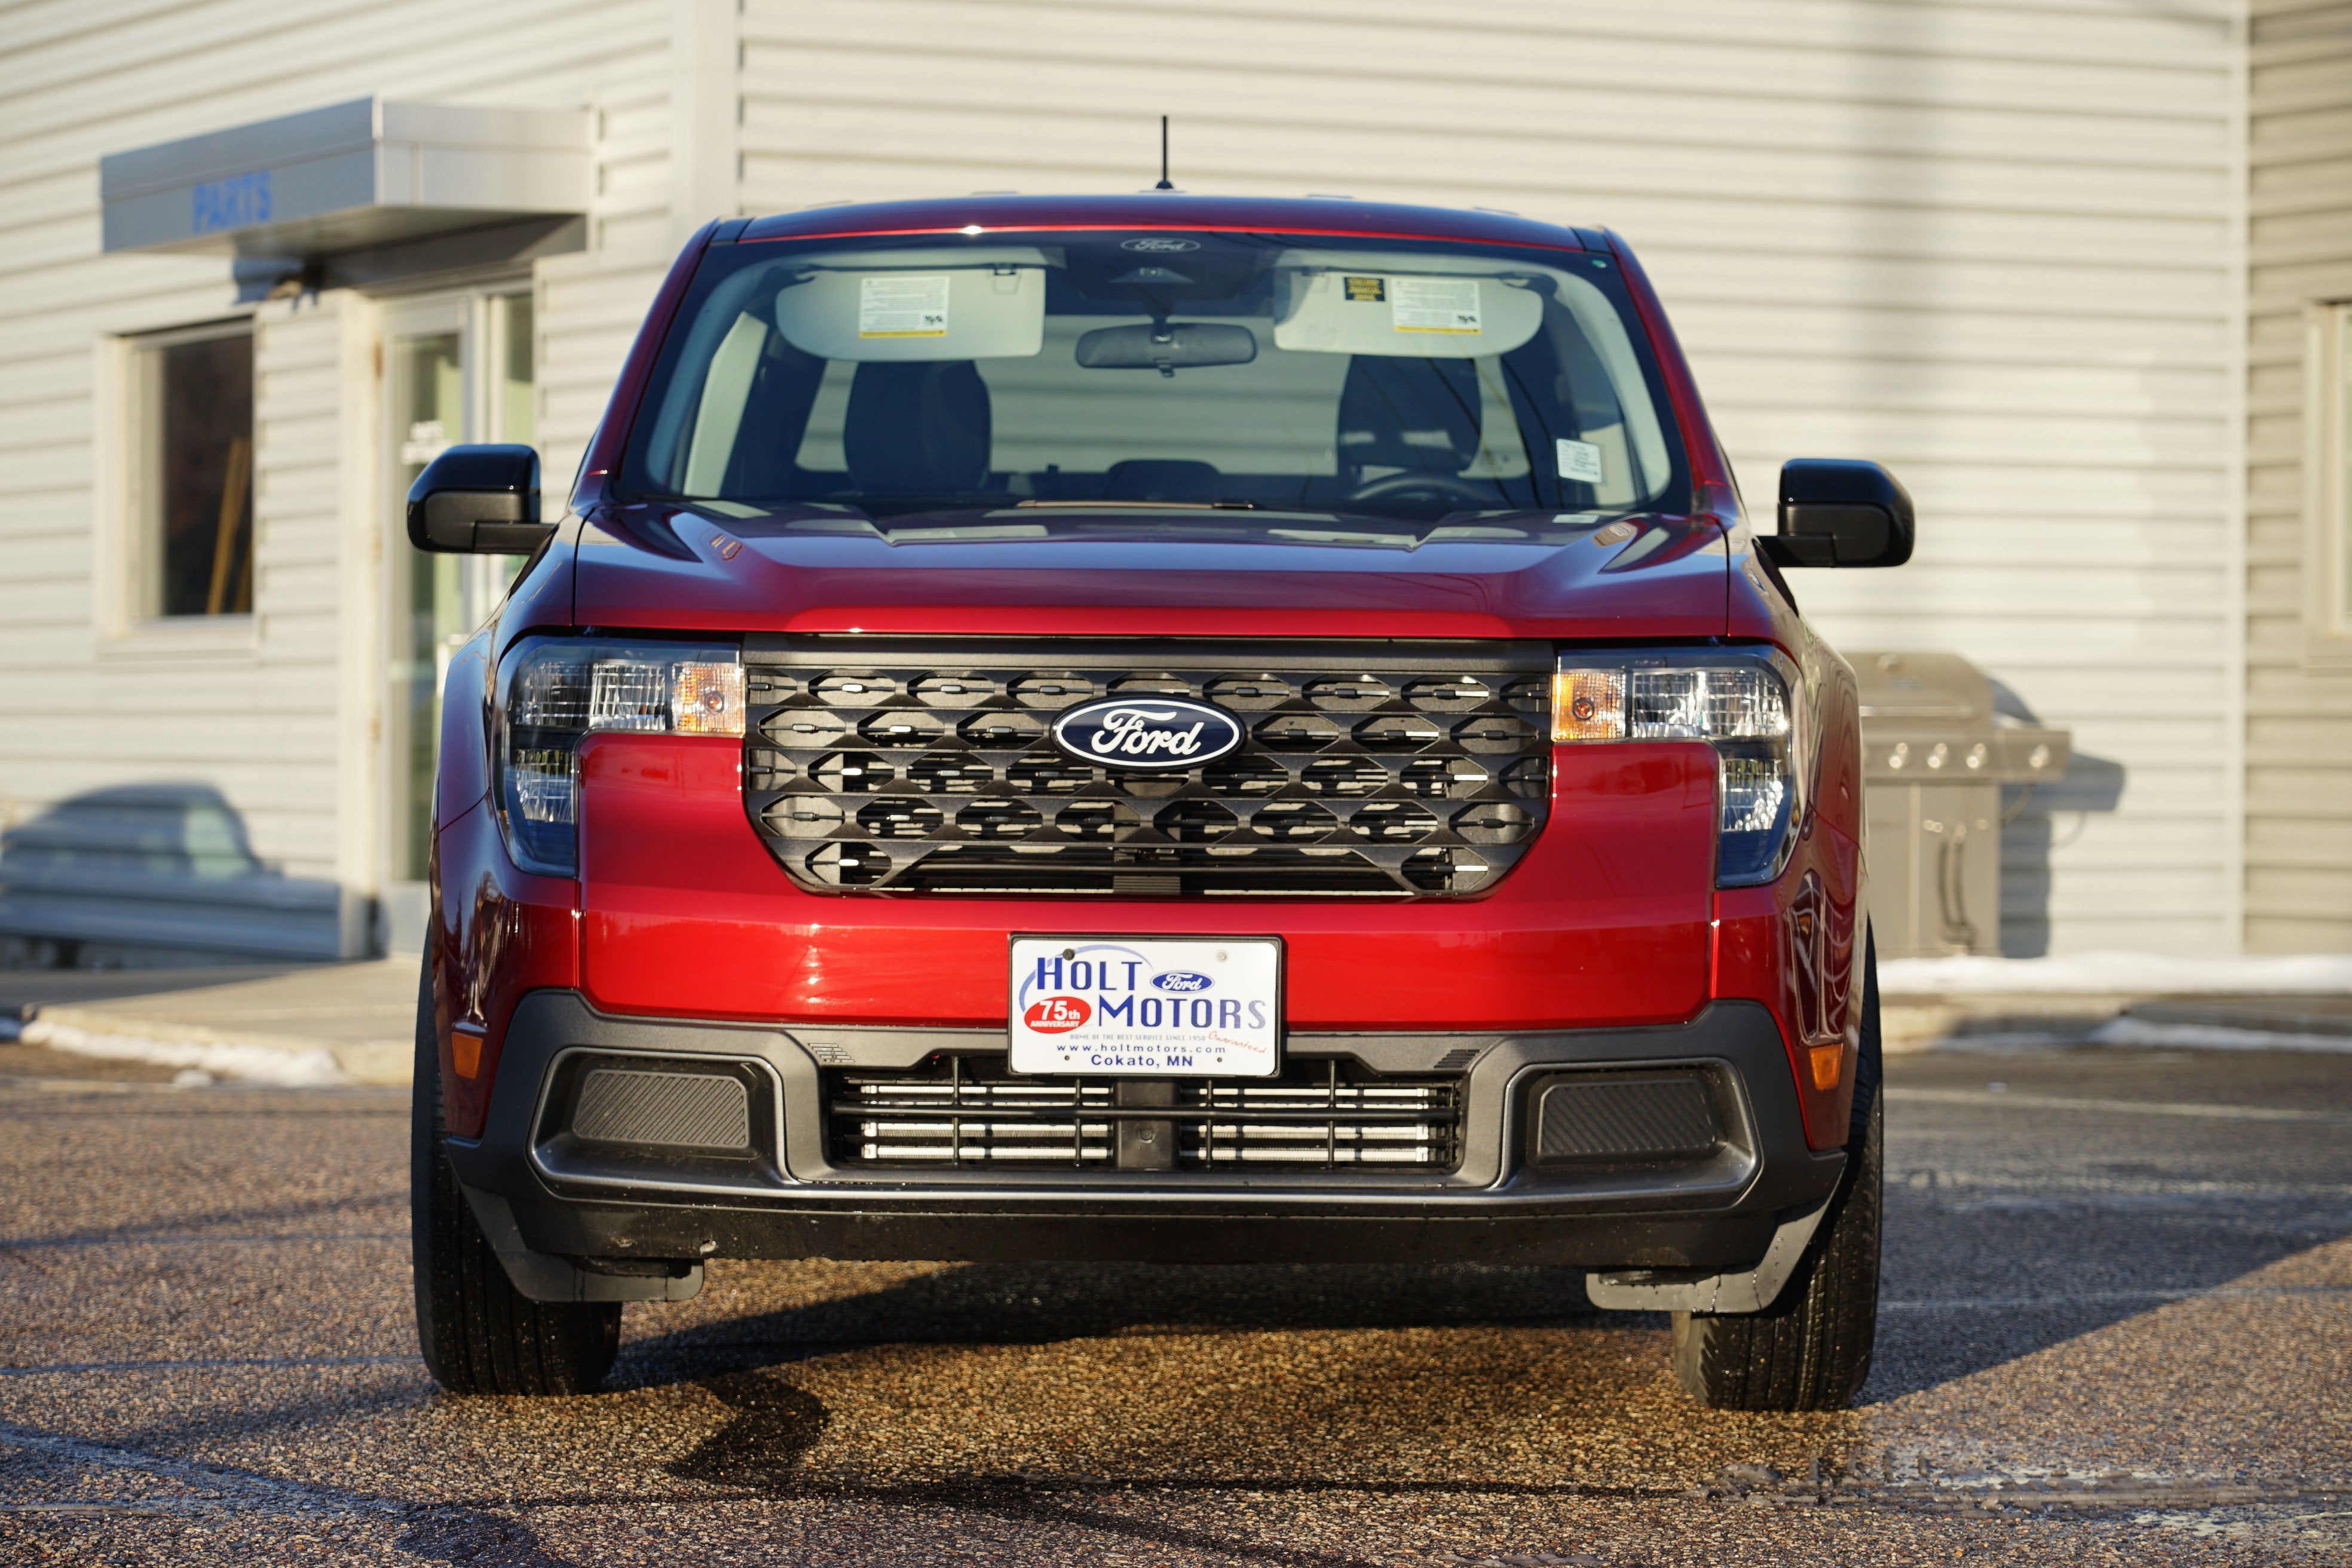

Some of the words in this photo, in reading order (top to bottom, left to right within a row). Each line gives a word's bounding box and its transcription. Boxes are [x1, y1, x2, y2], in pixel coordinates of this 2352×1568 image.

[193, 169, 271, 234] PARTS
[1135, 239, 1186, 251] Ford
[1091, 709, 1204, 755] Ford
[1037, 957, 1142, 990] HOLT
[1161, 973, 1202, 991] Ford
[1039, 1000, 1080, 1020] 75th
[1099, 994, 1266, 1029] MOTORS
[1057, 1044, 1225, 1053] www.holtmotors.com
[1091, 1054, 1159, 1068] Cokato,
[1167, 1056, 1193, 1066] MN
